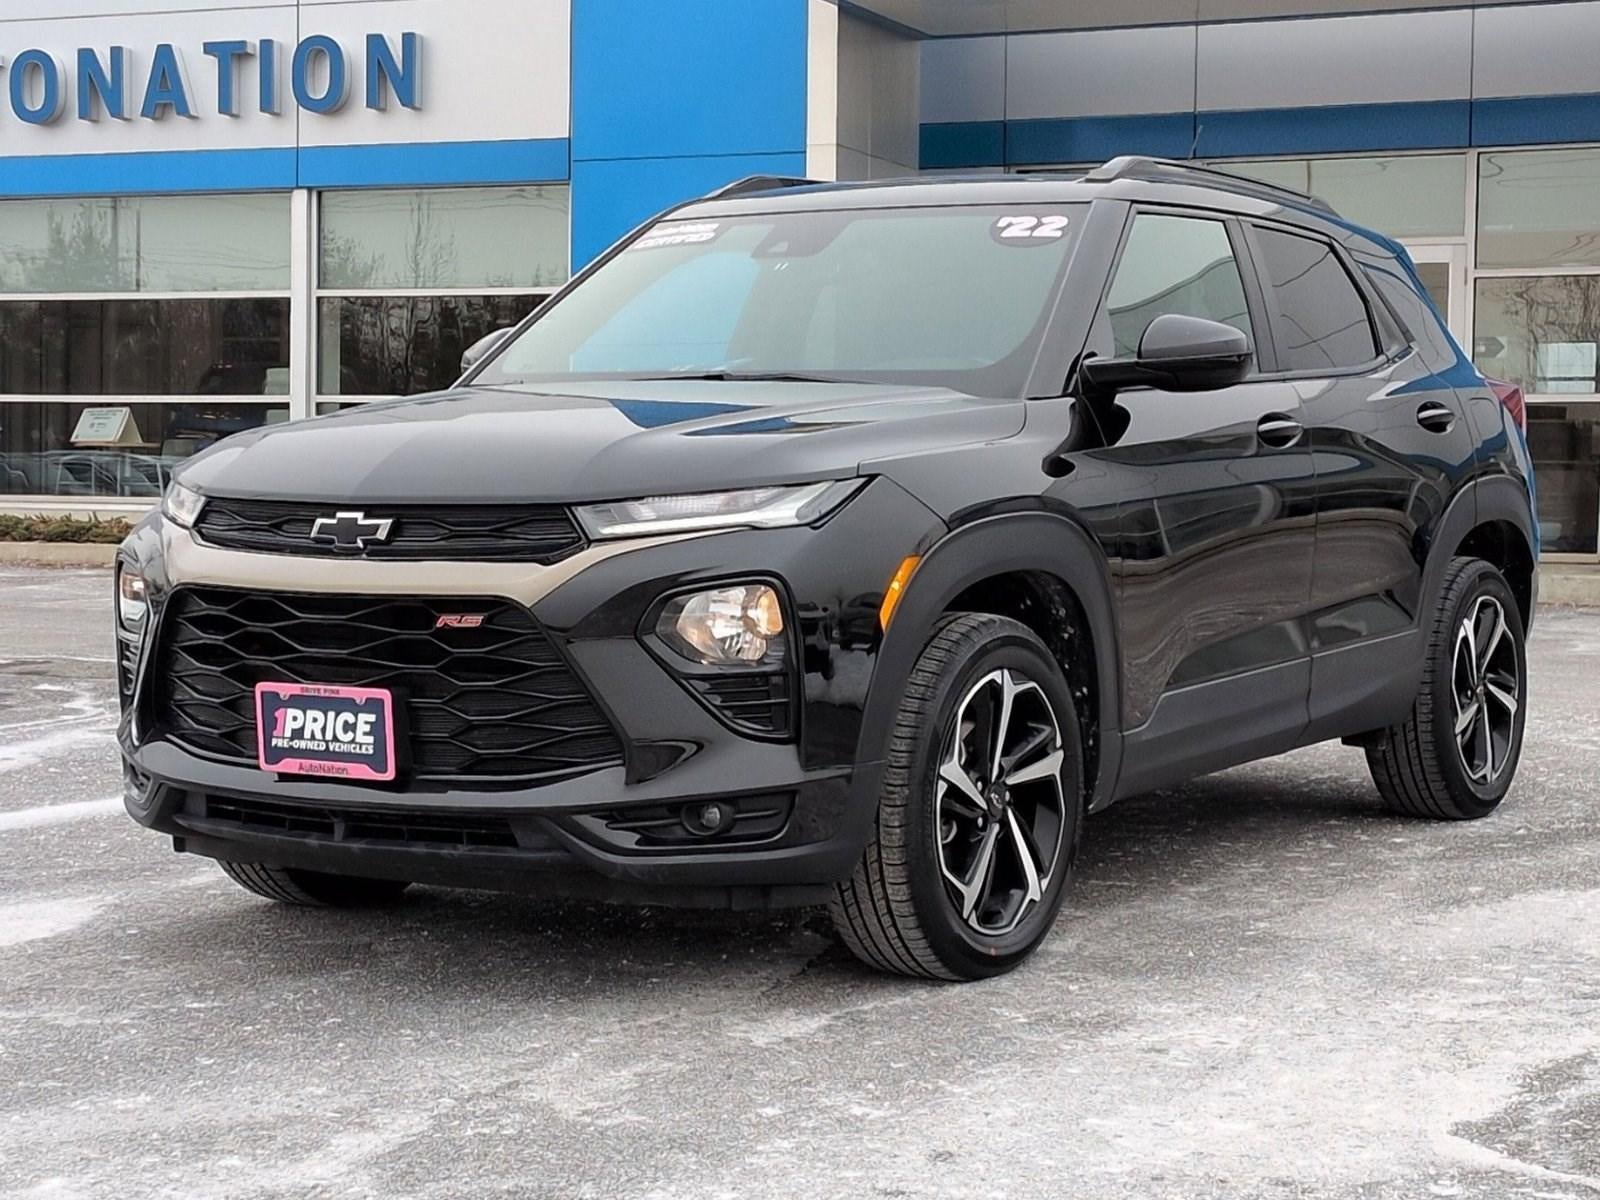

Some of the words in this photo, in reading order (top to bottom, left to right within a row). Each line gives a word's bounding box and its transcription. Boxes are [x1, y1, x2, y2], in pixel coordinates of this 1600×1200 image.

[0, 31, 424, 126] ONATION
[436, 615, 484, 628] RS
[272, 738, 326, 751] PRE-OWNED
[328, 742, 374, 755] VEHICLES
[298, 762, 349, 775] AutoNation
